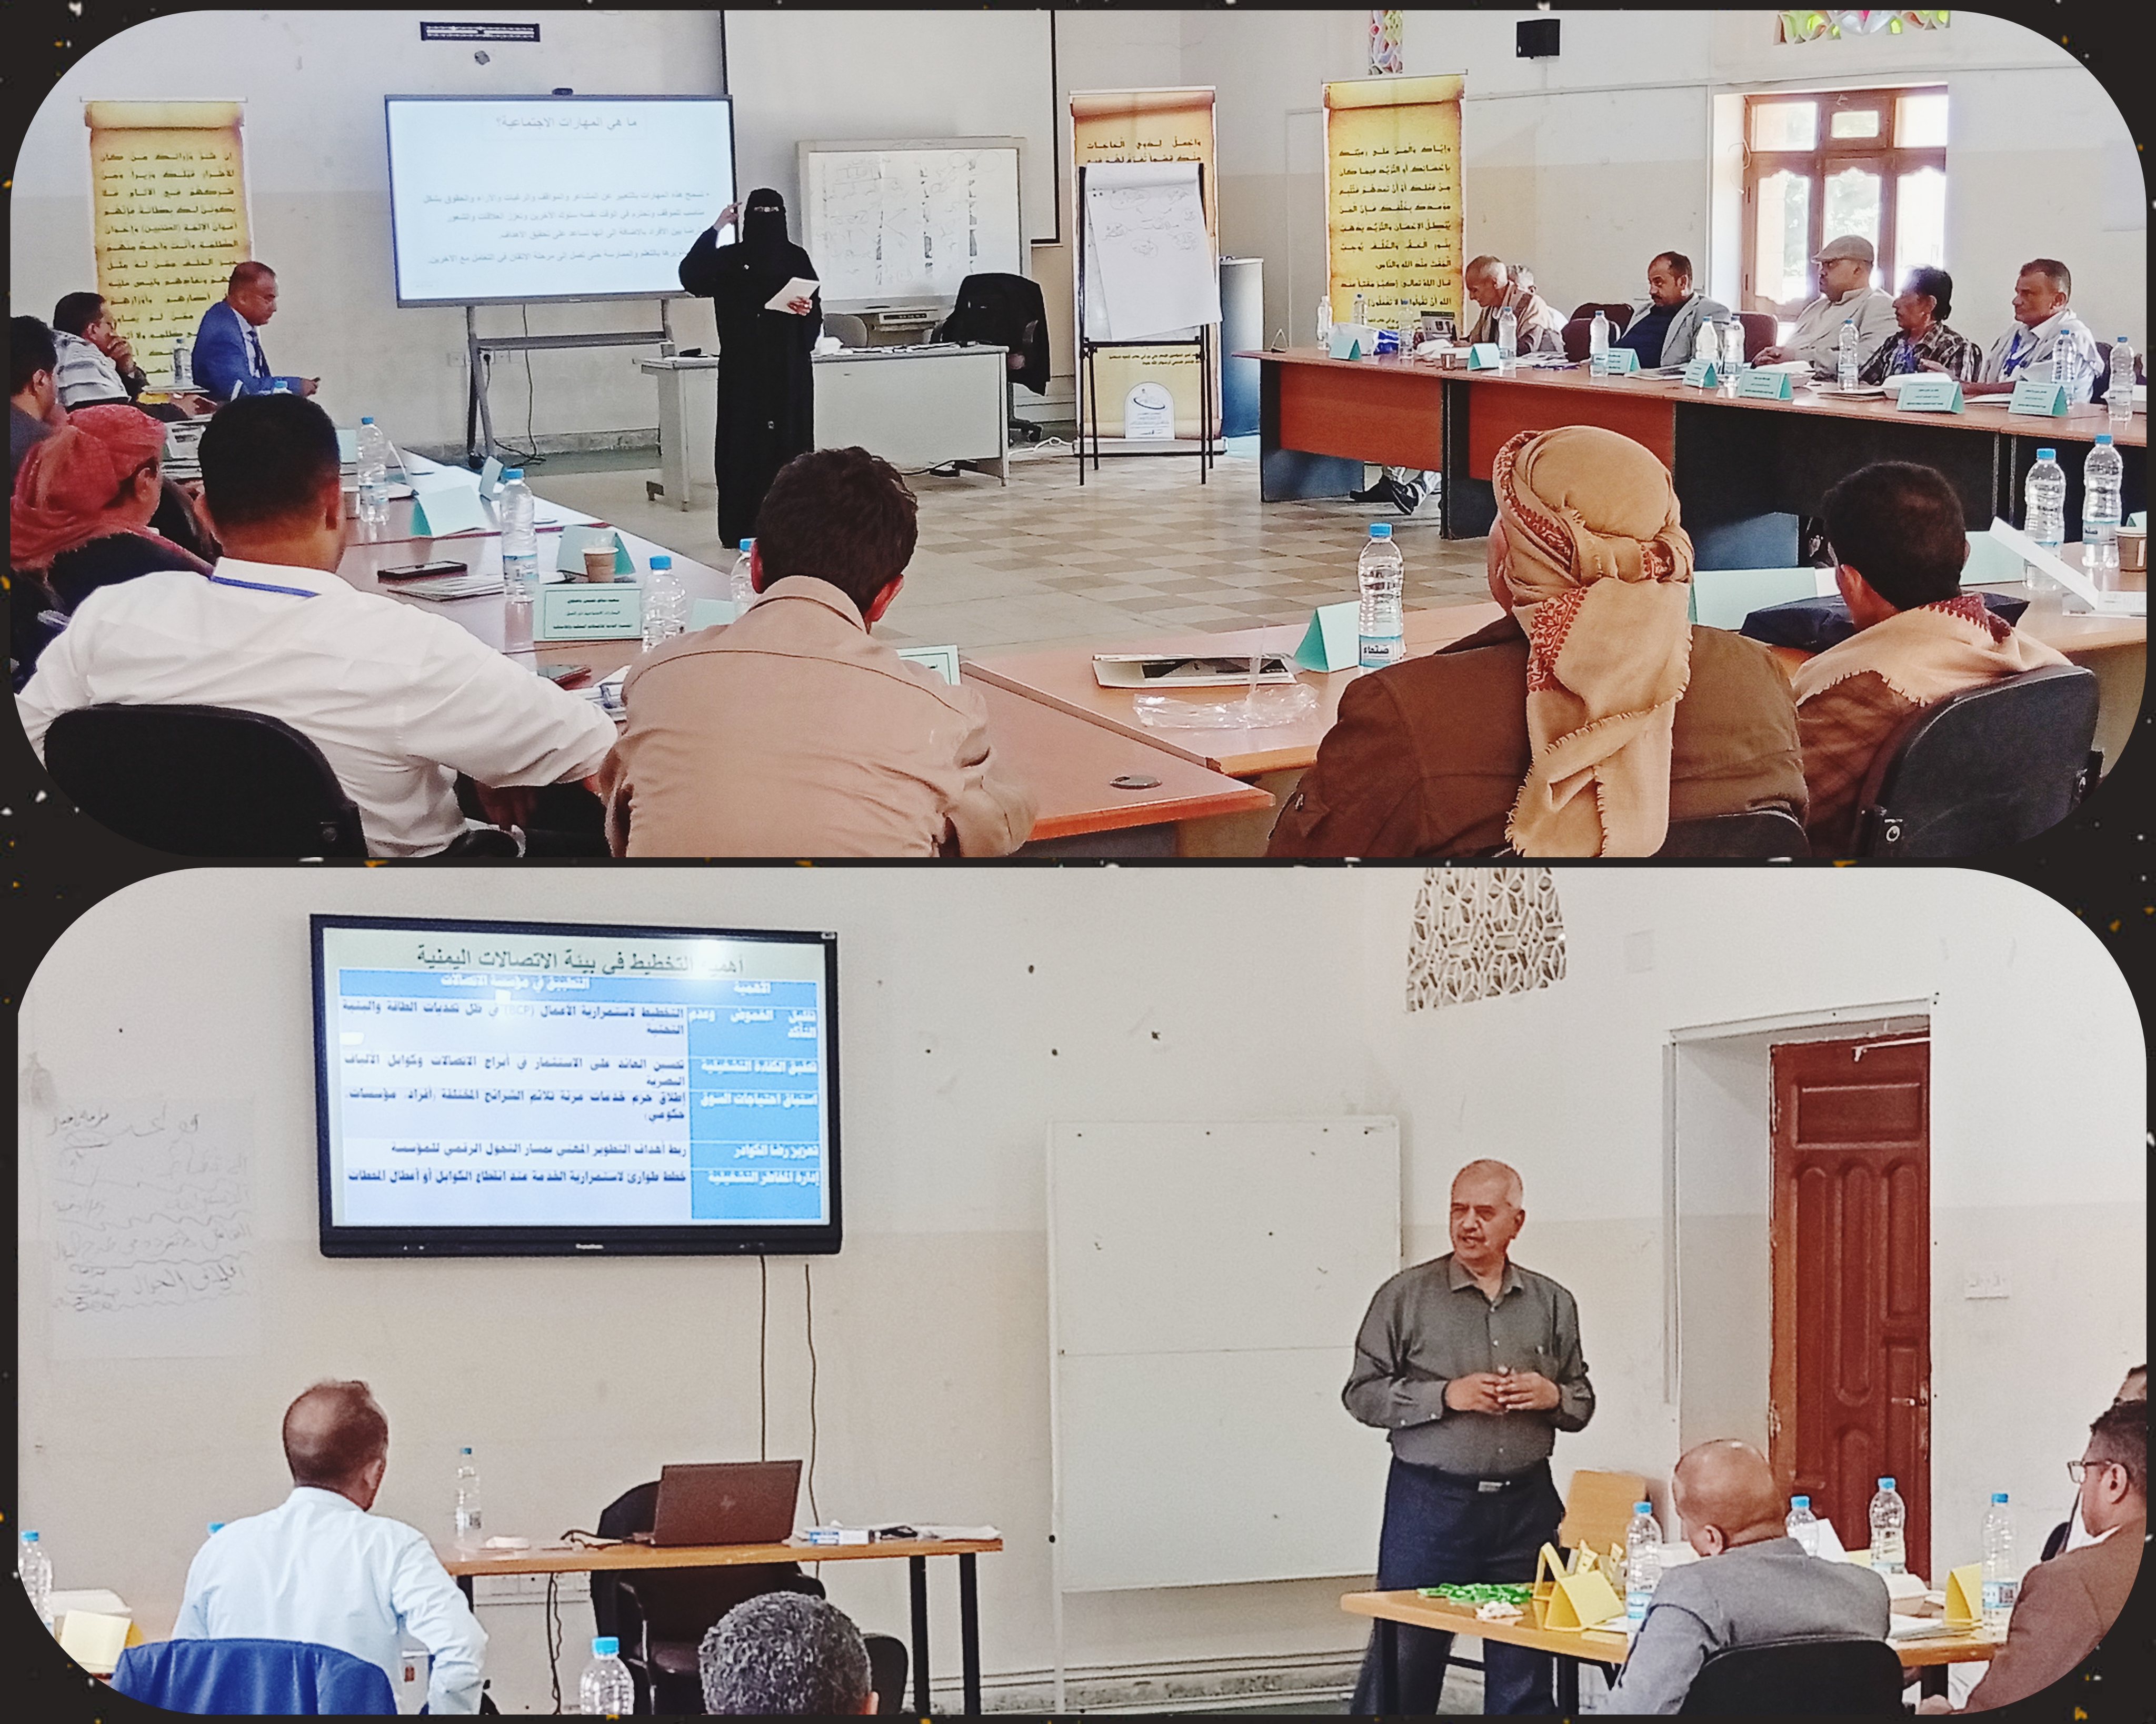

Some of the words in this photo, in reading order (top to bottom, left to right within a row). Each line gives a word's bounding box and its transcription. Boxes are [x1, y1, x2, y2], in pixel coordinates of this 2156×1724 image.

[559, 117, 603, 131] المهارات
[607, 118, 622, 131] هي
[626, 117, 637, 127] ما
[1363, 645, 1390, 654] صنعاء
[417, 944, 471, 970] اليمنية
[478, 949, 557, 968] الاتصالات
[630, 952, 693, 974] التخطيط
[440, 974, 489, 987] الاتصالات
